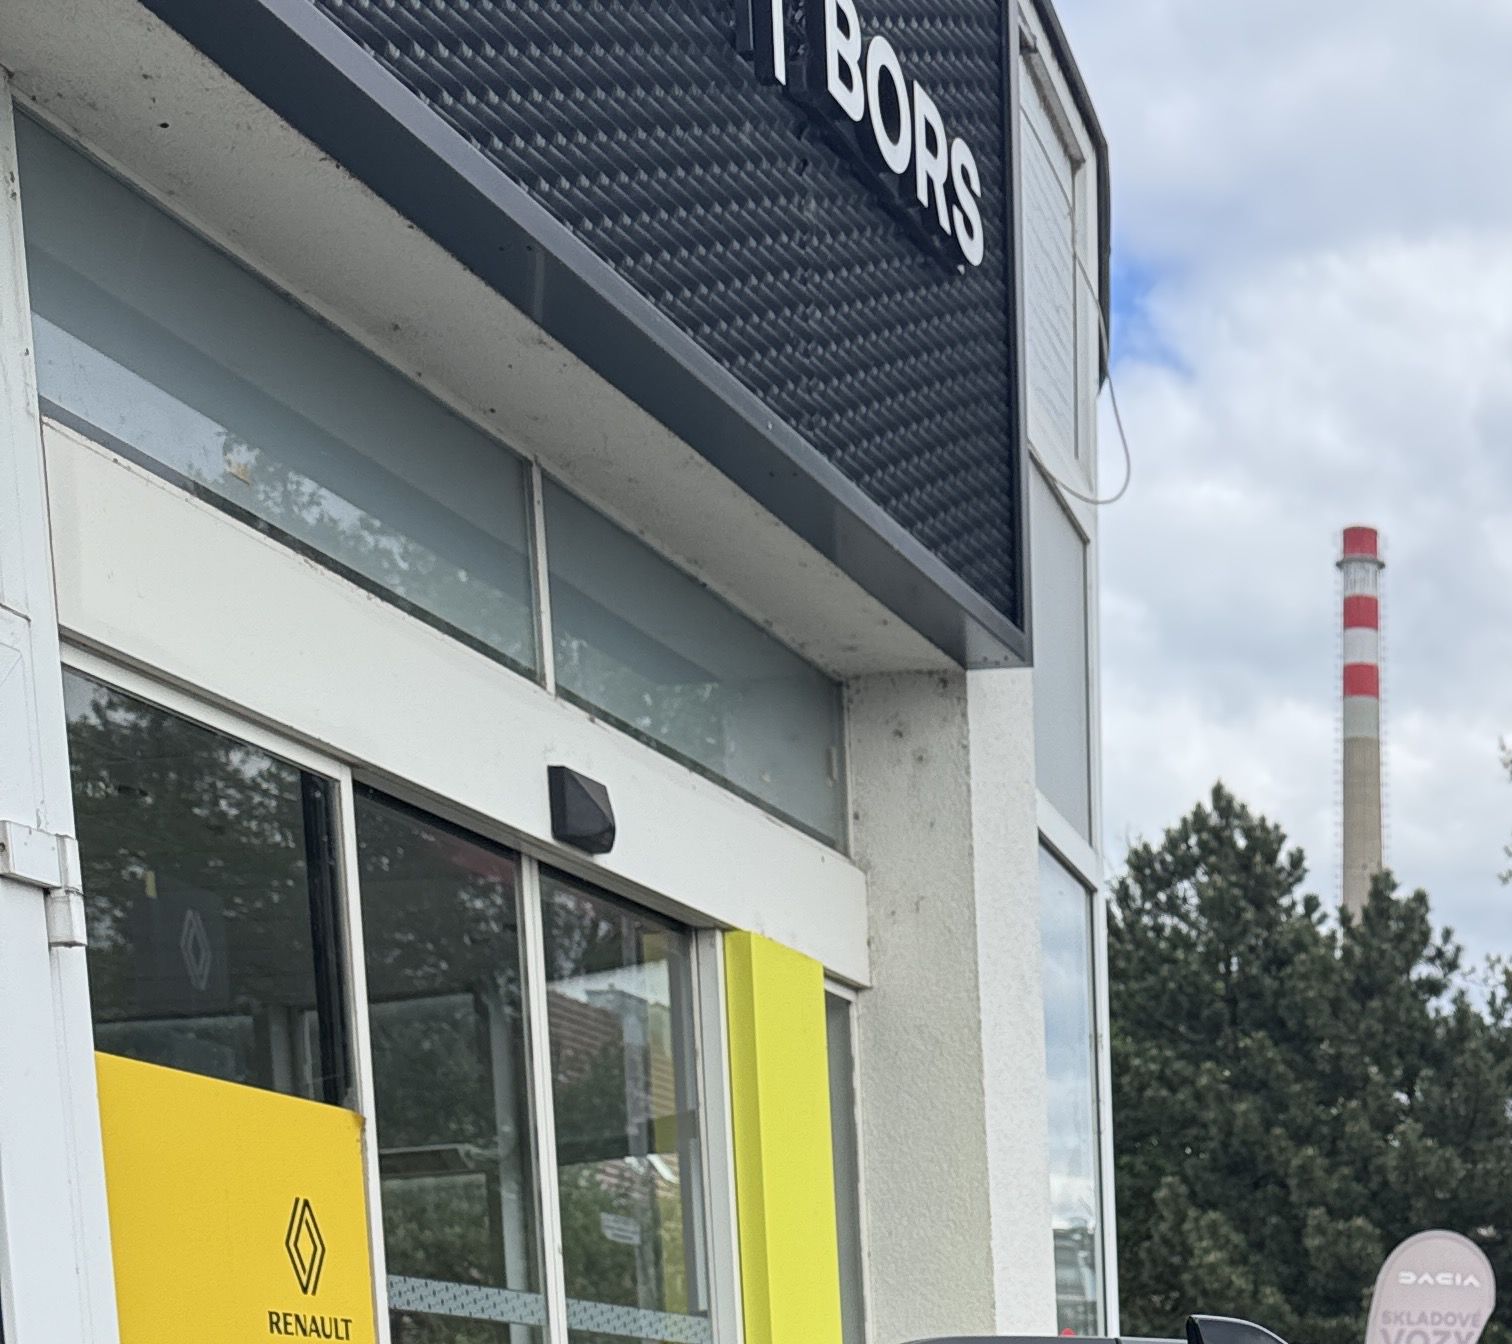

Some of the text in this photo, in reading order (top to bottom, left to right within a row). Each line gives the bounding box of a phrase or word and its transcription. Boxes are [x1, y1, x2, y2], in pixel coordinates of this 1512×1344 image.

[824, 0, 984, 267] BORS
[1399, 1271, 1481, 1288] DACIA
[267, 1310, 353, 1341] RENAULT
